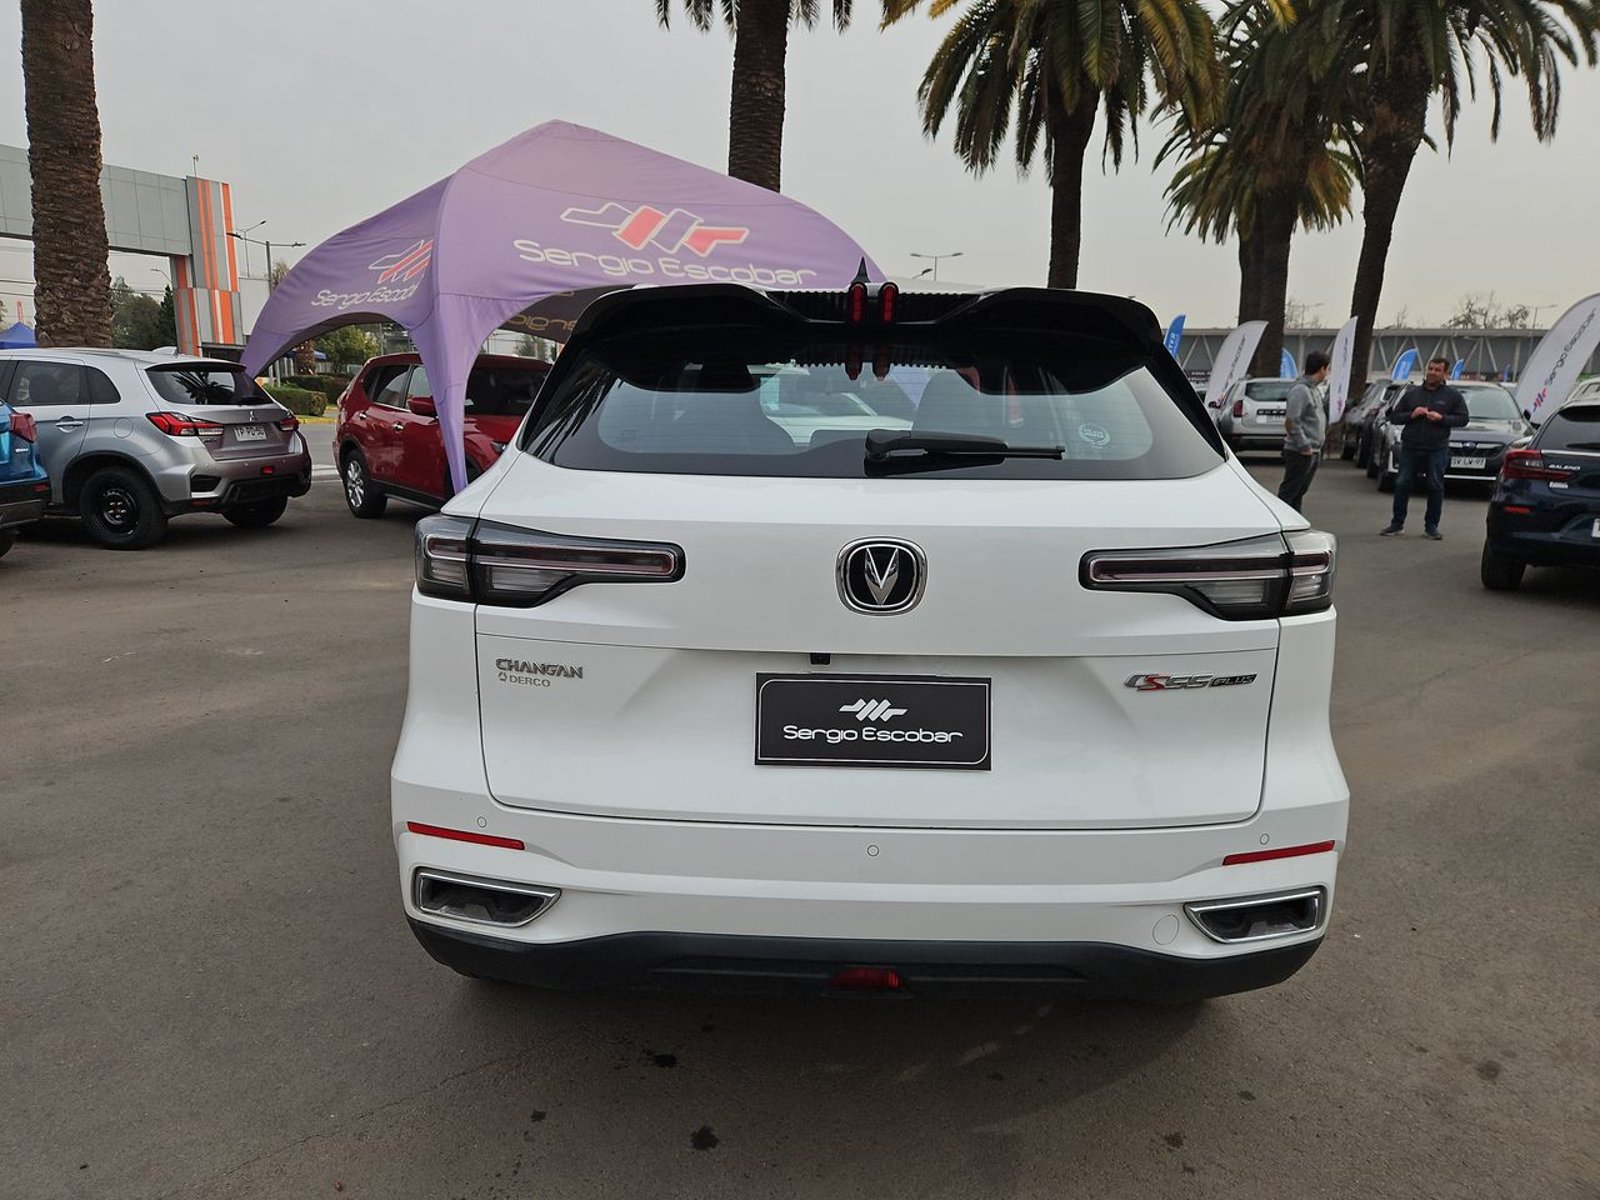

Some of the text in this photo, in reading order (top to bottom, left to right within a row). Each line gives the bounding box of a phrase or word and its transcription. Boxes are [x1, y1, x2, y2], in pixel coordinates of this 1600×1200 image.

[512, 238, 818, 286] Sergio Escobar
[495, 658, 584, 679] CHANGAN
[508, 675, 552, 687] DERCO
[783, 725, 964, 744] Sergio Escobar
